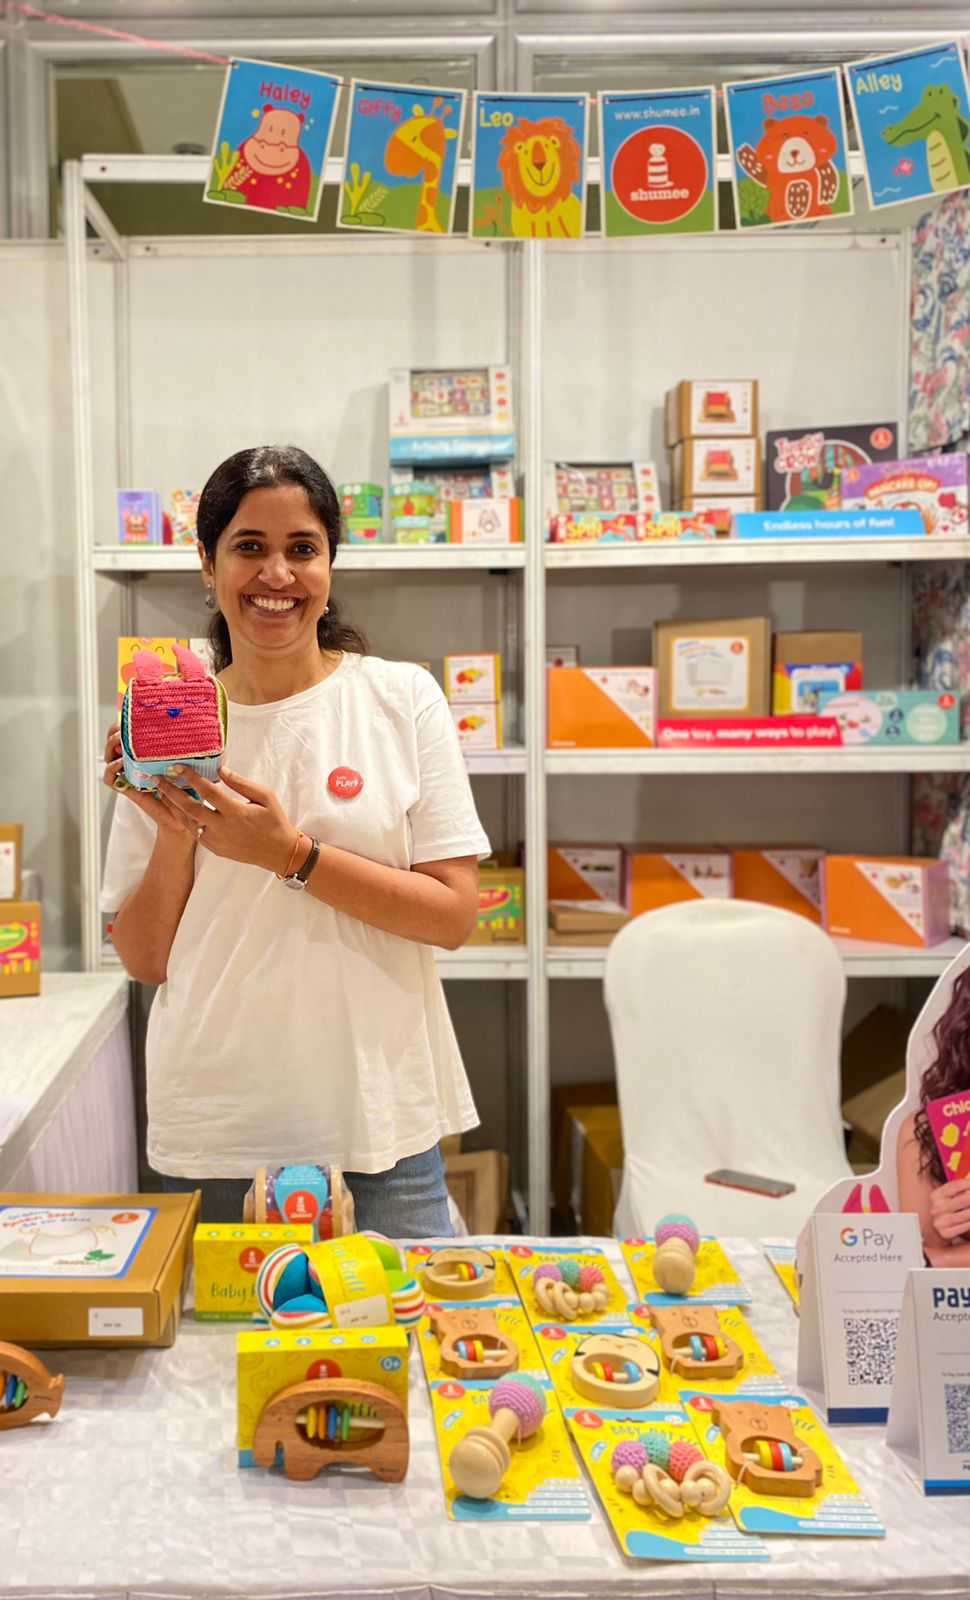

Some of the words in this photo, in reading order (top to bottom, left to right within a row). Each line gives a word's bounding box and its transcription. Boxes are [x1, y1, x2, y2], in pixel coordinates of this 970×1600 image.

[856, 72, 902, 95] Alley
[259, 80, 311, 110] Haley
[480, 106, 514, 128] Leo
[614, 104, 700, 121] www.shumee.in
[630, 188, 689, 202] shumee
[763, 519, 812, 531] Endless
[814, 518, 850, 530] hours
[852, 517, 865, 529] of
[868, 516, 895, 529] fun!
[662, 727, 690, 740] One
[691, 728, 714, 742] toy,
[716, 728, 753, 741] many
[755, 727, 788, 740] ways
[789, 725, 804, 738] to
[806, 724, 837, 740] play!
[834, 1253, 878, 1264] Accepted
[880, 1253, 902, 1262] Here
